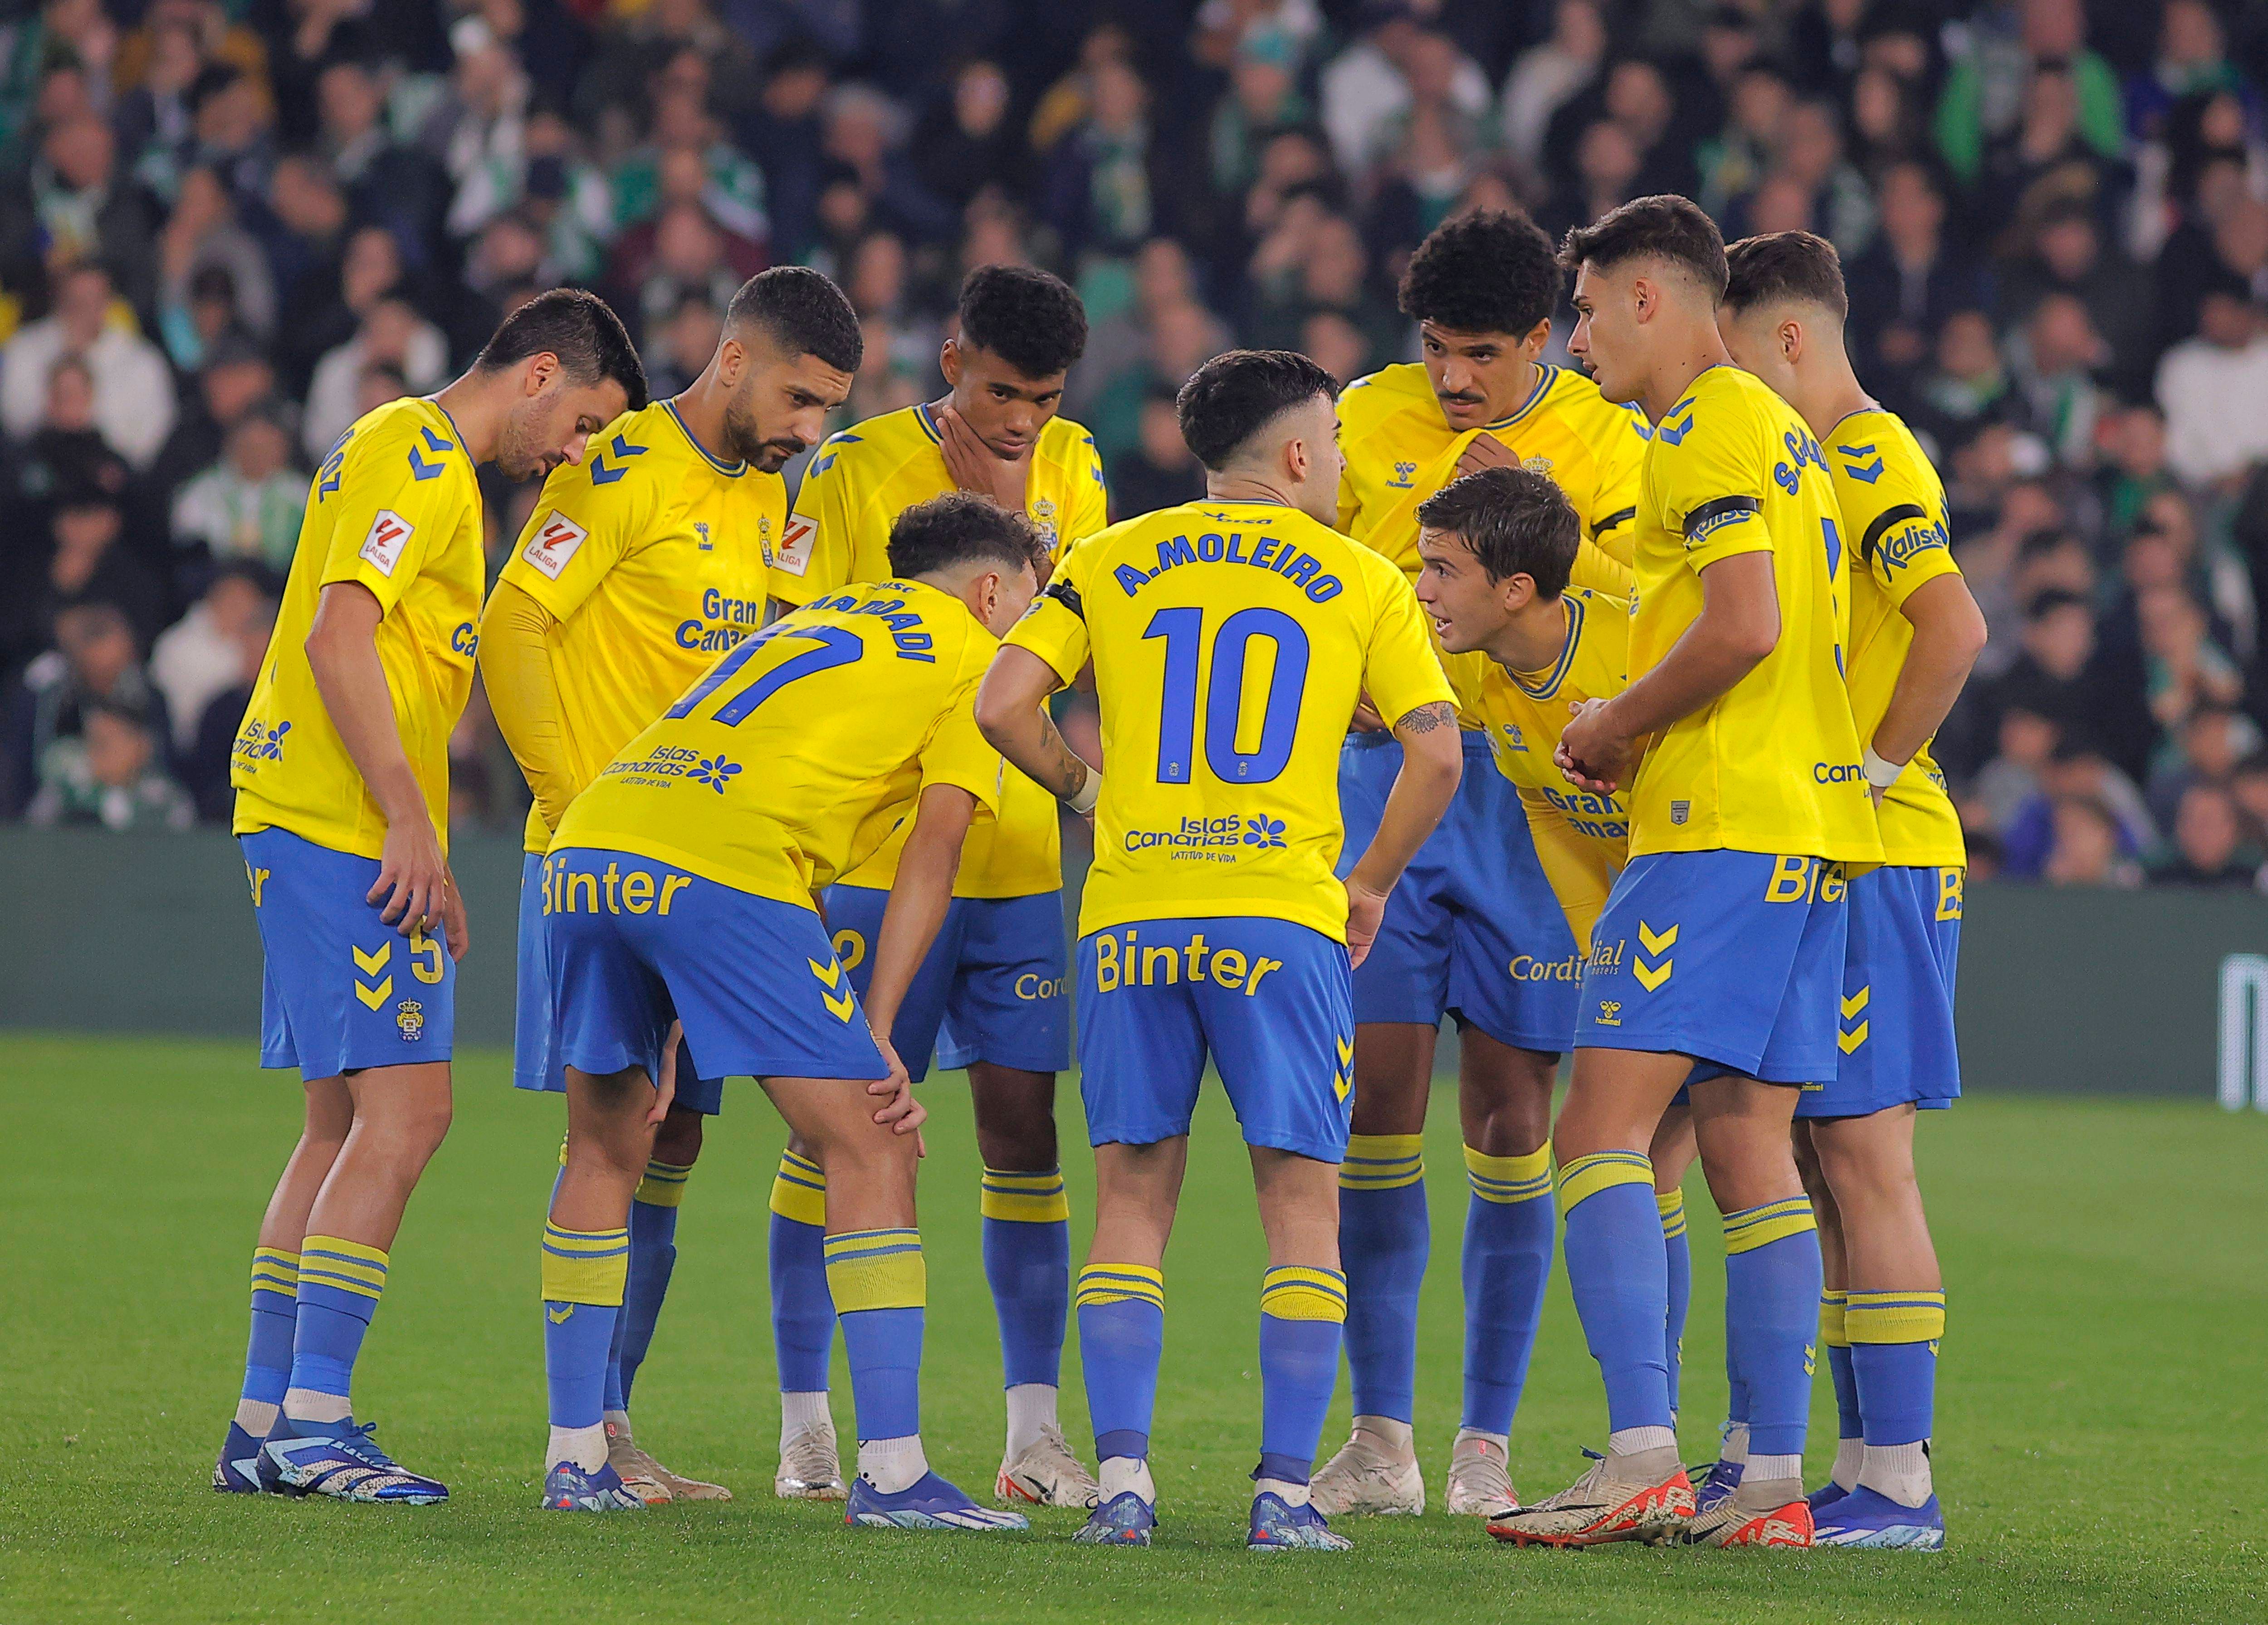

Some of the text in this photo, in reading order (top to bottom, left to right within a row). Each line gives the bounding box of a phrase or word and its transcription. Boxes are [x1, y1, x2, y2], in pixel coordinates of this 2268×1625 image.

[365, 545, 390, 567] LALIGA
[529, 546, 557, 570] LALIGA
[1875, 525, 1942, 583] Kalise
[1113, 533, 1343, 604] A.MOLEIRO
[703, 588, 756, 625] Gran
[662, 624, 863, 727] 17
[1141, 606, 1310, 785] 10
[244, 717, 266, 739] Isl
[648, 745, 699, 762] Islas
[657, 780, 671, 789] VIDA
[1542, 786, 1623, 815] Gran
[1180, 814, 1240, 834] Islas
[1567, 818, 1628, 838] ana
[1125, 830, 1239, 852] Canarias
[1171, 851, 1236, 863] LATITUD DE VIDA
[410, 915, 444, 984] 5
[1096, 930, 1283, 996] Binter
